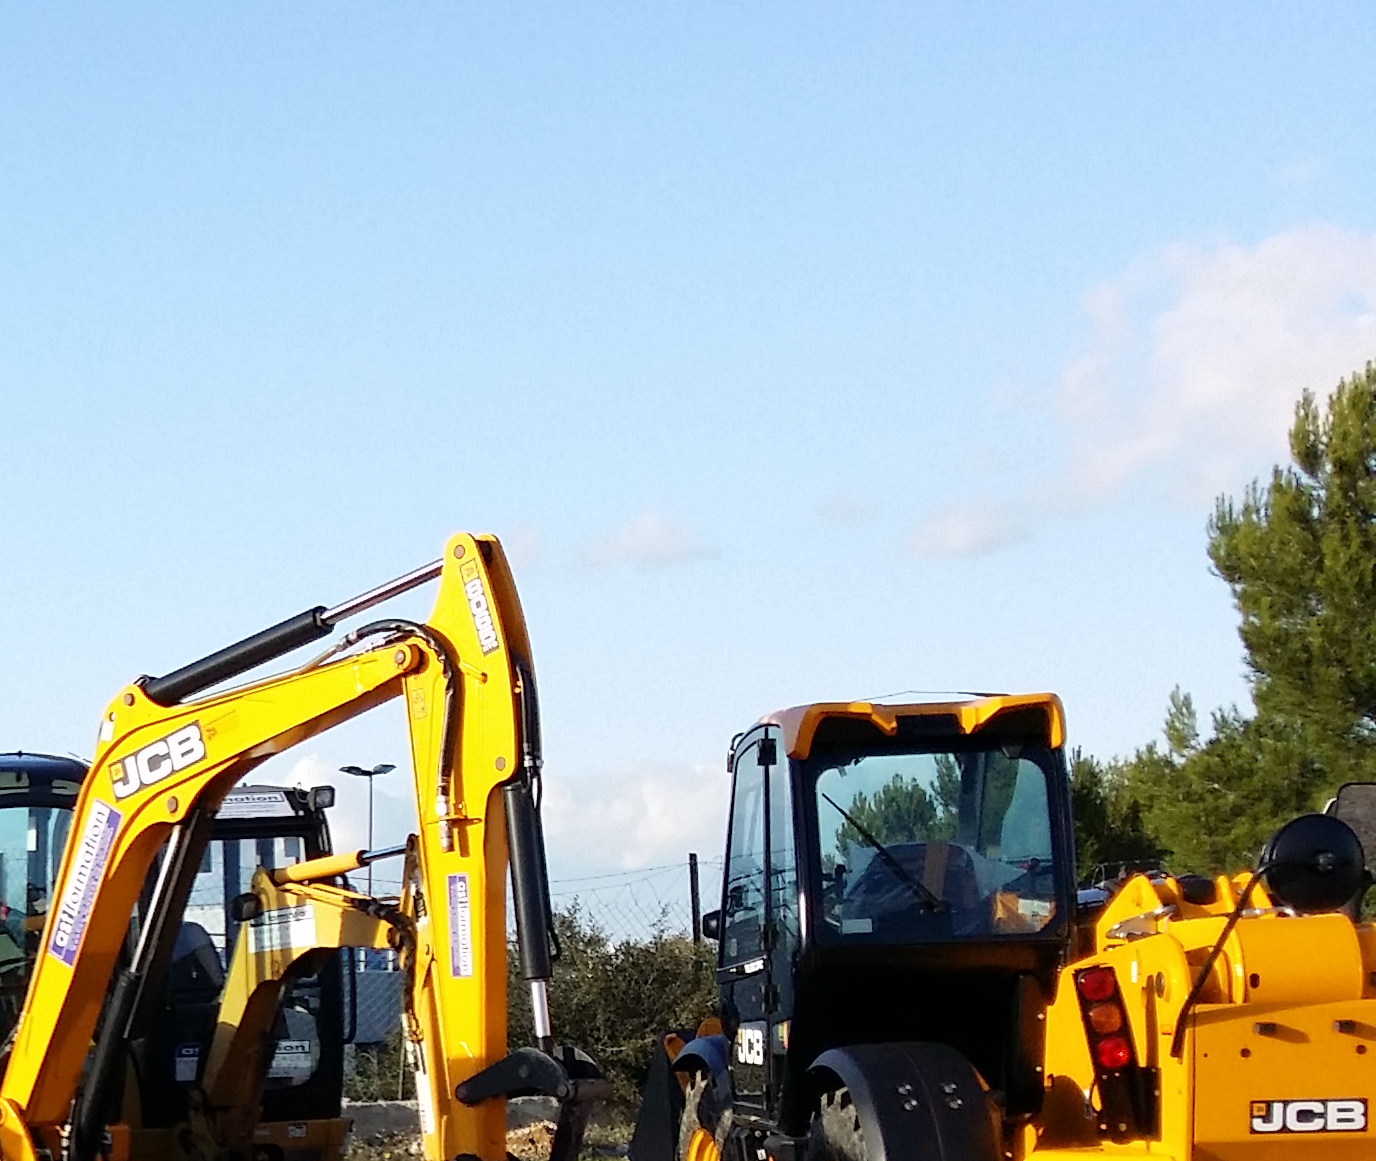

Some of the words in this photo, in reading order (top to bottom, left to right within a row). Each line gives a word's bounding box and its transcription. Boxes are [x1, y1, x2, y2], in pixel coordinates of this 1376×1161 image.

[113, 724, 206, 799] JCB
[737, 1028, 763, 1065] JCB
[1252, 1101, 1366, 1132] JCB
